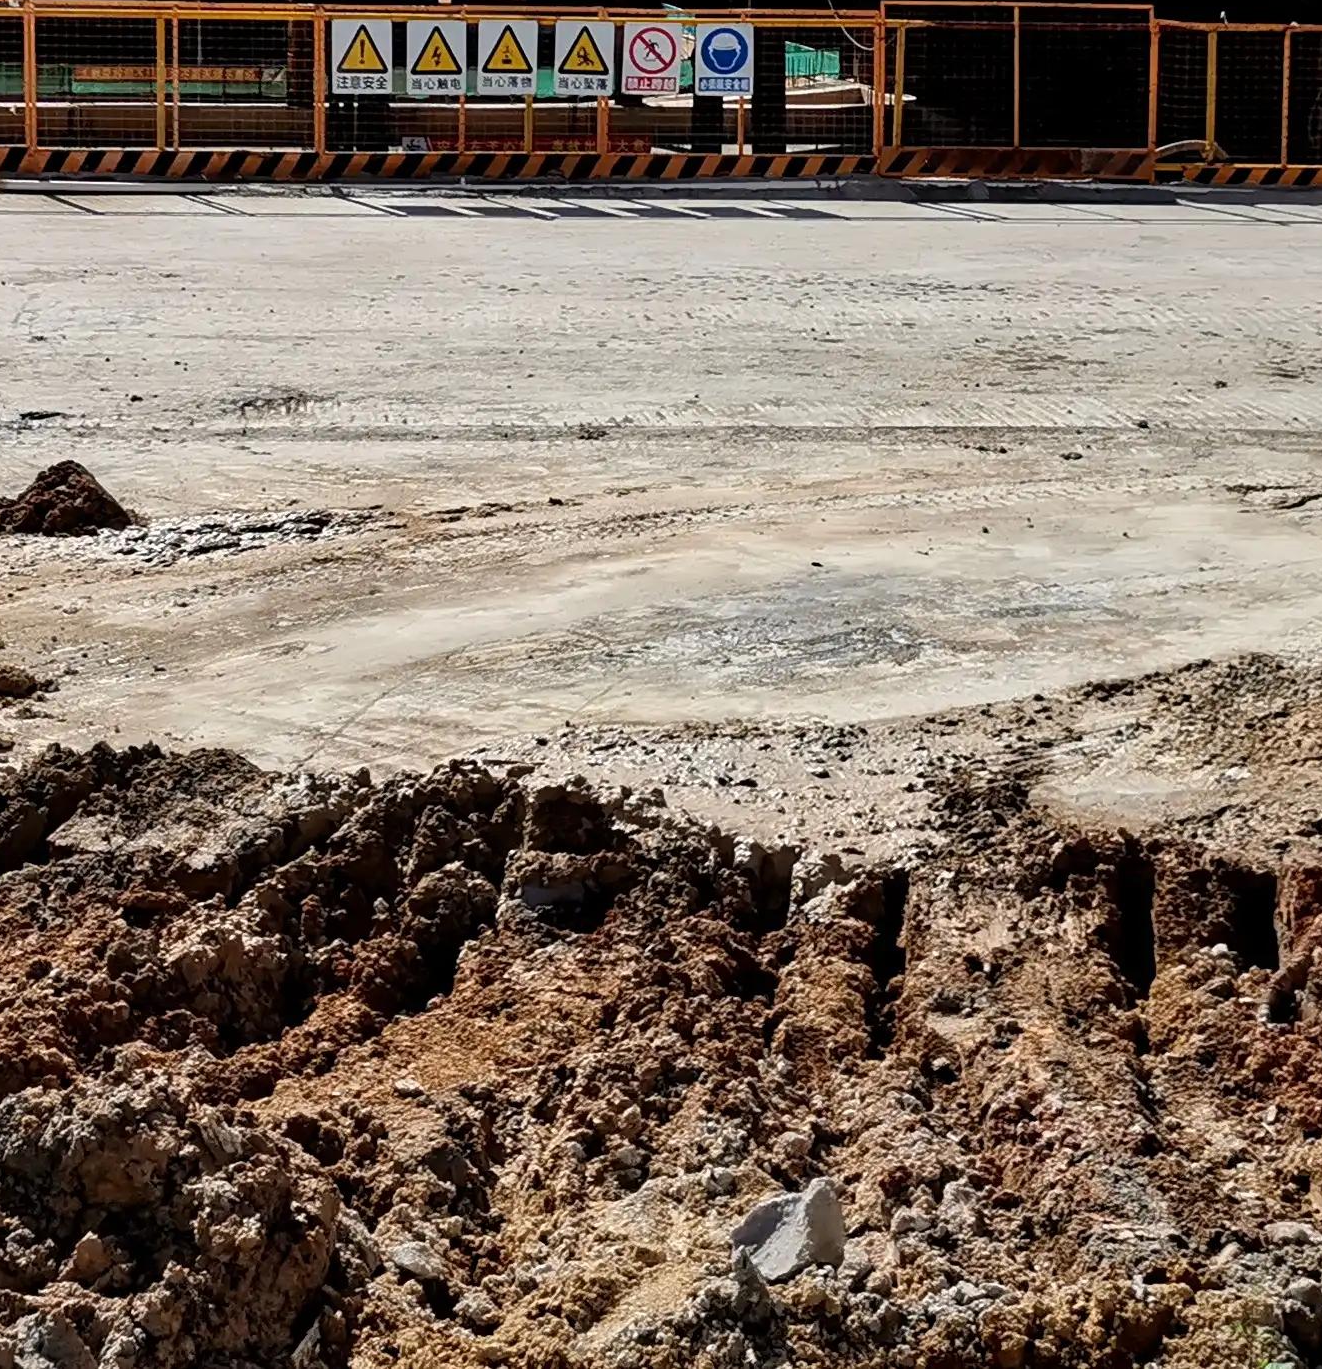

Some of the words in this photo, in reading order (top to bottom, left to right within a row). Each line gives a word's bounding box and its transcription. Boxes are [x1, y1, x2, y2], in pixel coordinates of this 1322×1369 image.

[336, 75, 389, 91] 注意安全
[411, 77, 462, 91] 当心触电
[481, 75, 533, 88] 当心落物
[558, 76, 609, 90] 当心坠落
